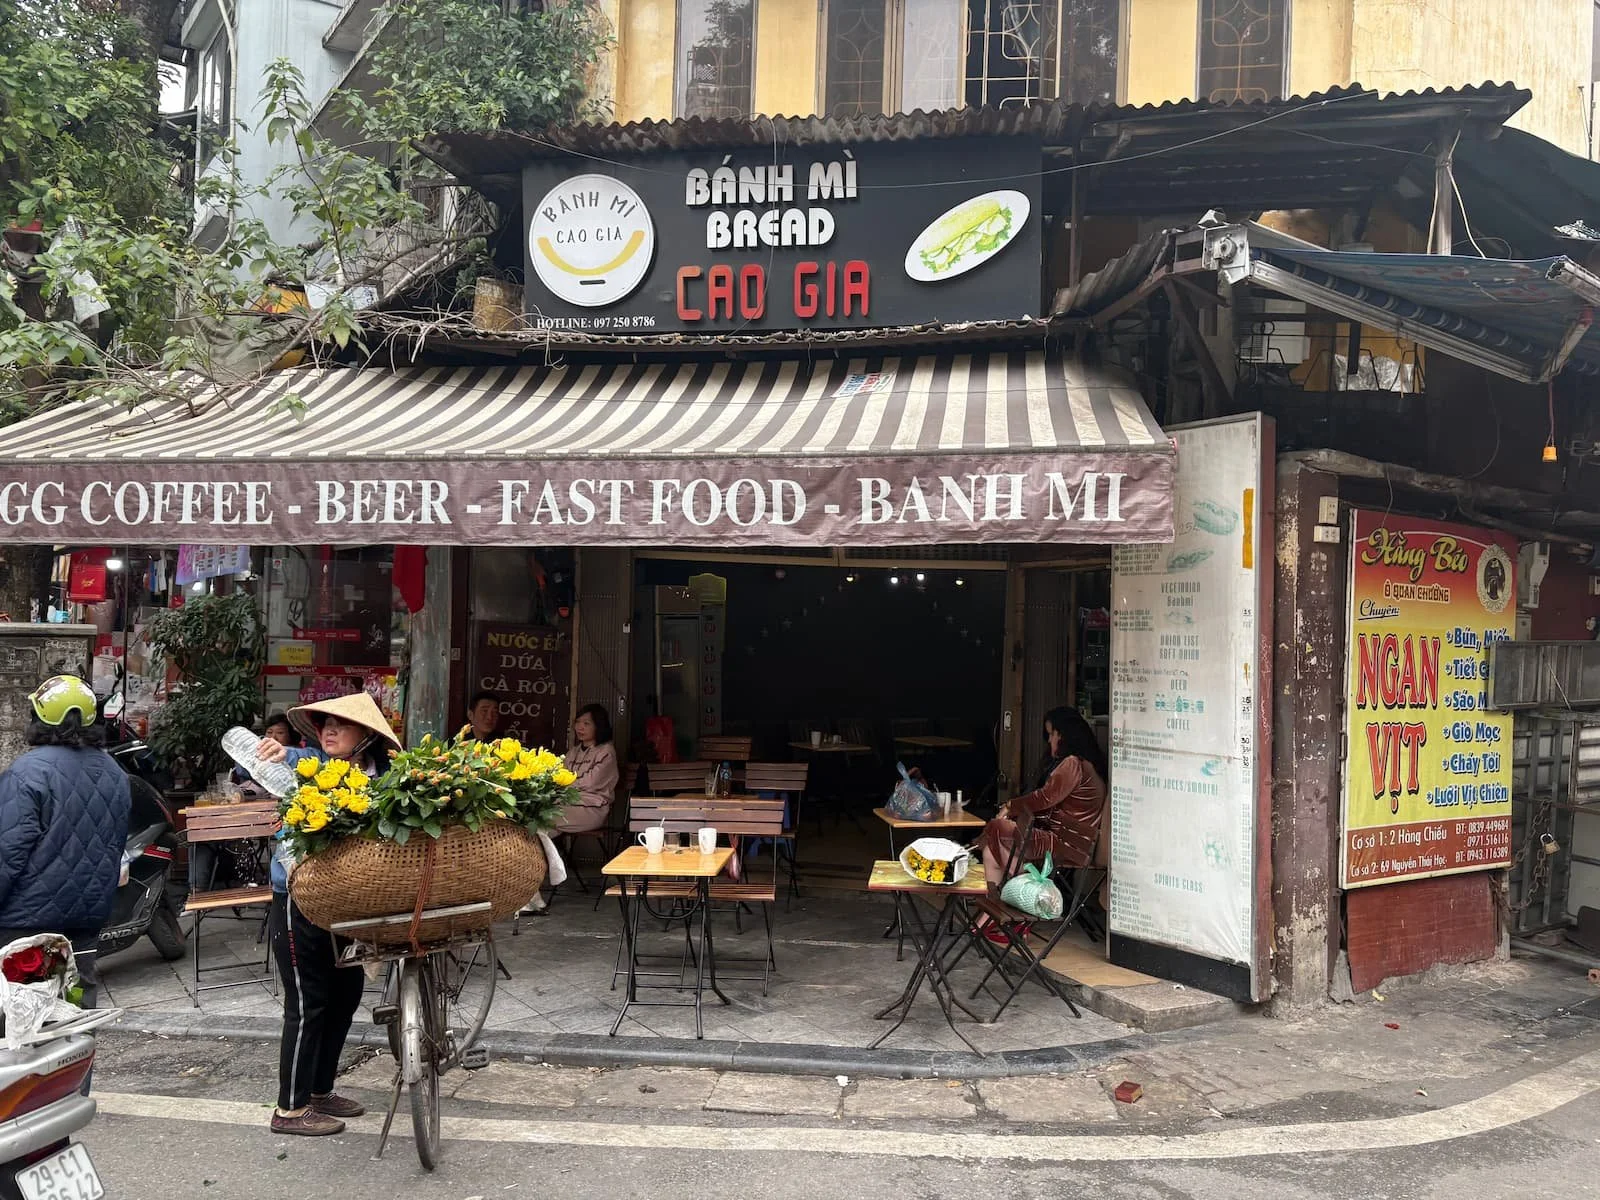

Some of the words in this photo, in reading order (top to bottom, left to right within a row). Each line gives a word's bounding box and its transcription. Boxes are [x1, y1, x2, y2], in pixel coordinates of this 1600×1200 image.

[686, 154, 794, 206] BÁNH
[808, 149, 857, 200] MÌ
[542, 191, 600, 223] BÁNH
[610, 194, 639, 218] MÌ
[556, 229, 587, 244] CAO
[596, 226, 622, 242] GIA
[707, 207, 835, 249] BREAD
[676, 263, 765, 321] CAO
[794, 260, 870, 318] GIA
[536, 317, 592, 330] HOTLINE:
[593, 316, 610, 329] 097
[613, 317, 630, 328] 250
[632, 315, 656, 328] 8786
[80, 480, 273, 525] COFFEE
[315, 479, 453, 524] BEER
[497, 478, 635, 526] FAST
[648, 478, 807, 526] FOOD
[856, 473, 1029, 525] BANH
[1044, 472, 1128, 522] MI
[1393, 584, 1415, 600] QUAN
[487, 630, 538, 650] NƯỚC
[500, 651, 547, 671] DỨA
[1357, 633, 1441, 710] NGAN
[481, 673, 509, 692] CÀ
[498, 699, 541, 717] CÓC
[1366, 721, 1427, 814] VỊT
[1352, 834, 1363, 850] Cơ
[1389, 829, 1396, 845] 2
[1398, 828, 1421, 847] Hàng
[1380, 860, 1390, 873] 69
[99, 927, 139, 942] ONDA
[30, 1149, 83, 1196] 29-C1
